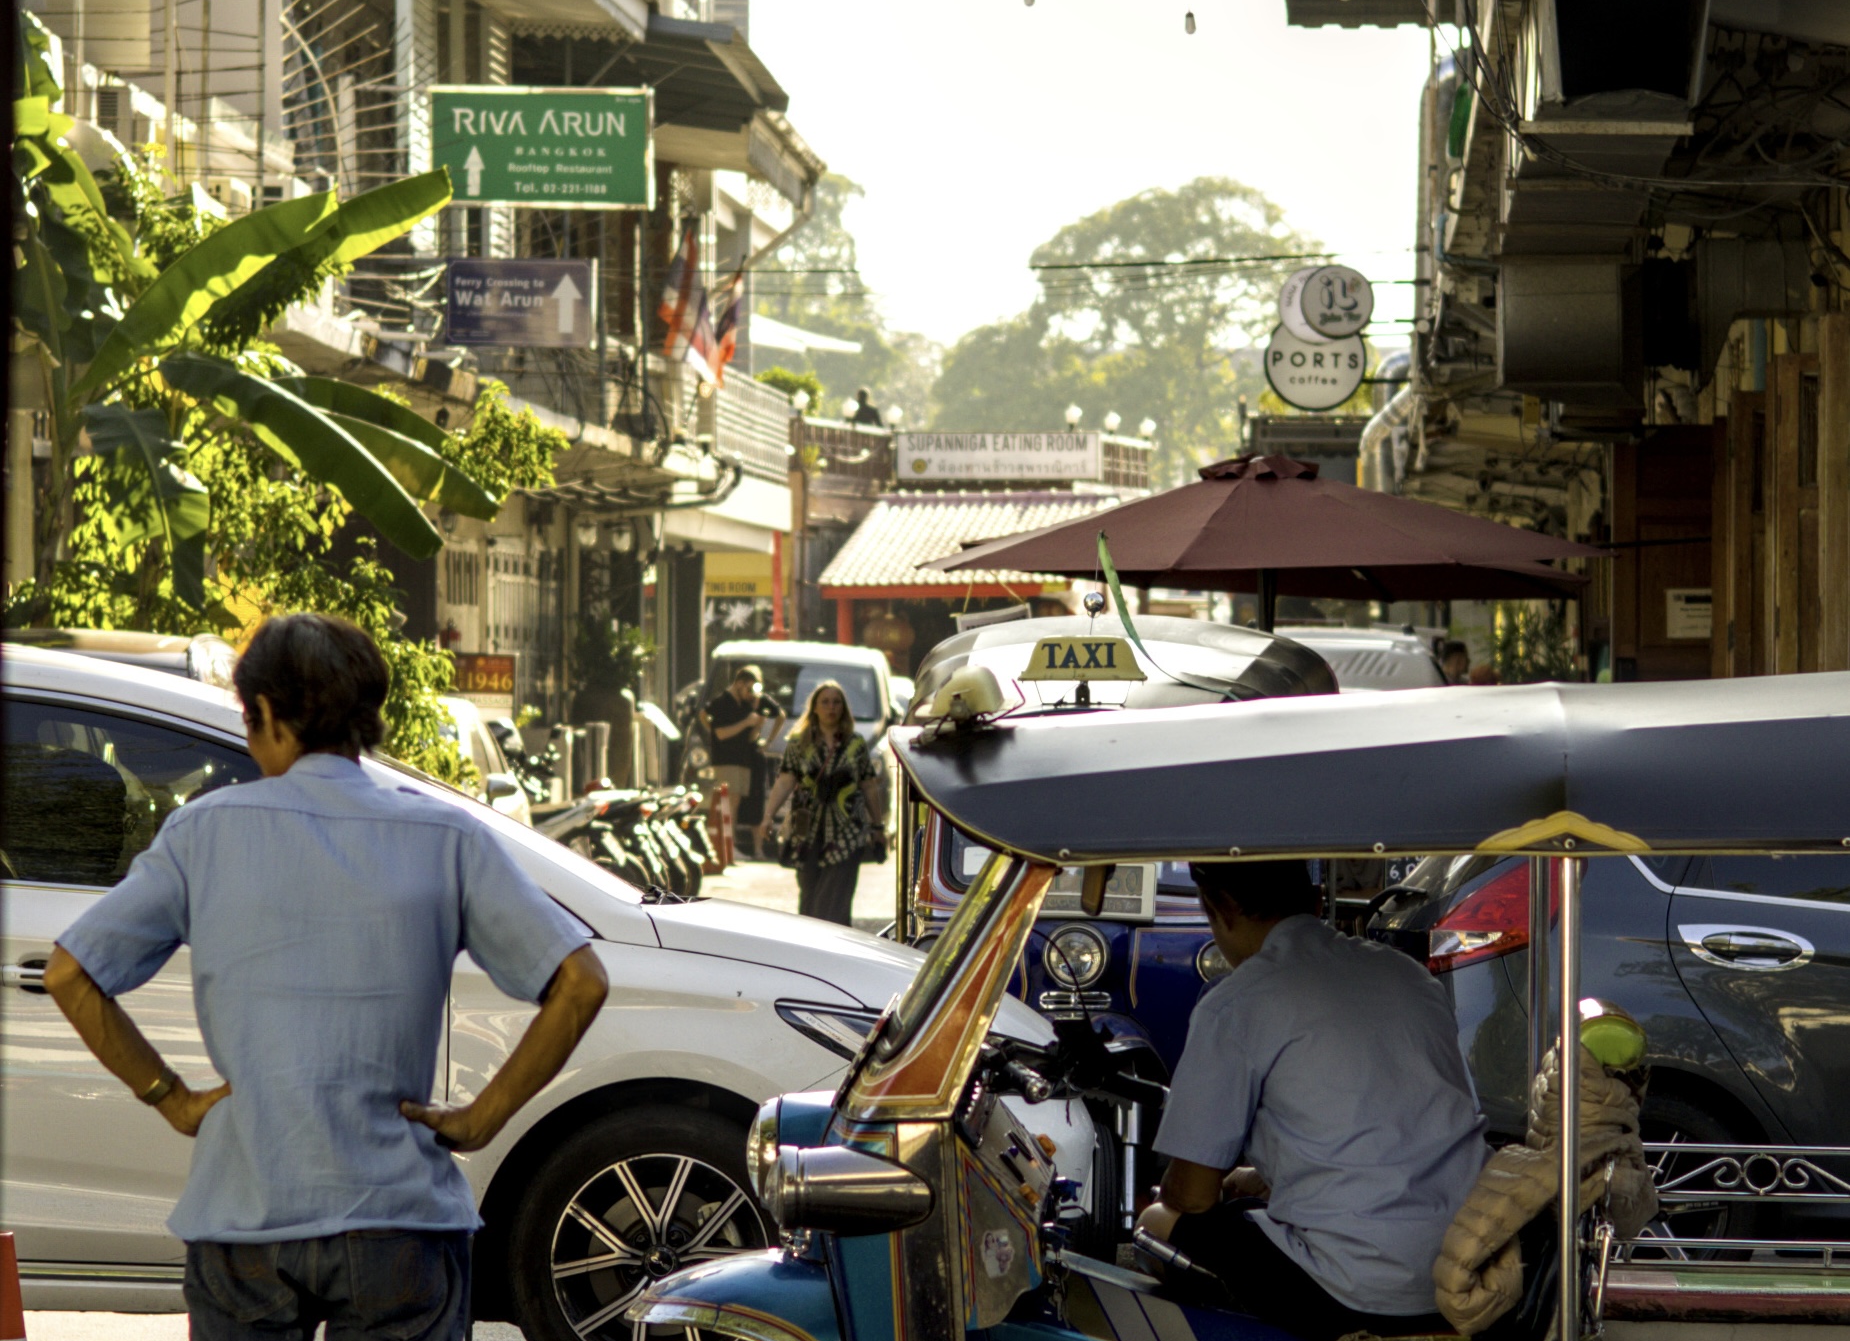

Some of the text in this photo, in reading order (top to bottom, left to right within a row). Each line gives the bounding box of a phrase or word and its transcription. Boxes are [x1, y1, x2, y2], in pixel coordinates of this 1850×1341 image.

[452, 107, 627, 137] RIVA ARUN
[514, 146, 607, 157] BANGKOK
[508, 163, 613, 175] Rooftop Restaurant
[514, 181, 539, 194] Tel.
[455, 277, 545, 290] Ferry Crossing to
[454, 290, 544, 308] Wat Arun
[1272, 350, 1359, 369] PORTS
[1289, 375, 1338, 385] coffee
[907, 434, 1088, 452] SUPANNIGA EATING ROOM
[728, 582, 756, 593] ROOM
[1041, 642, 1117, 669] TAXI
[467, 672, 513, 691] 1946
